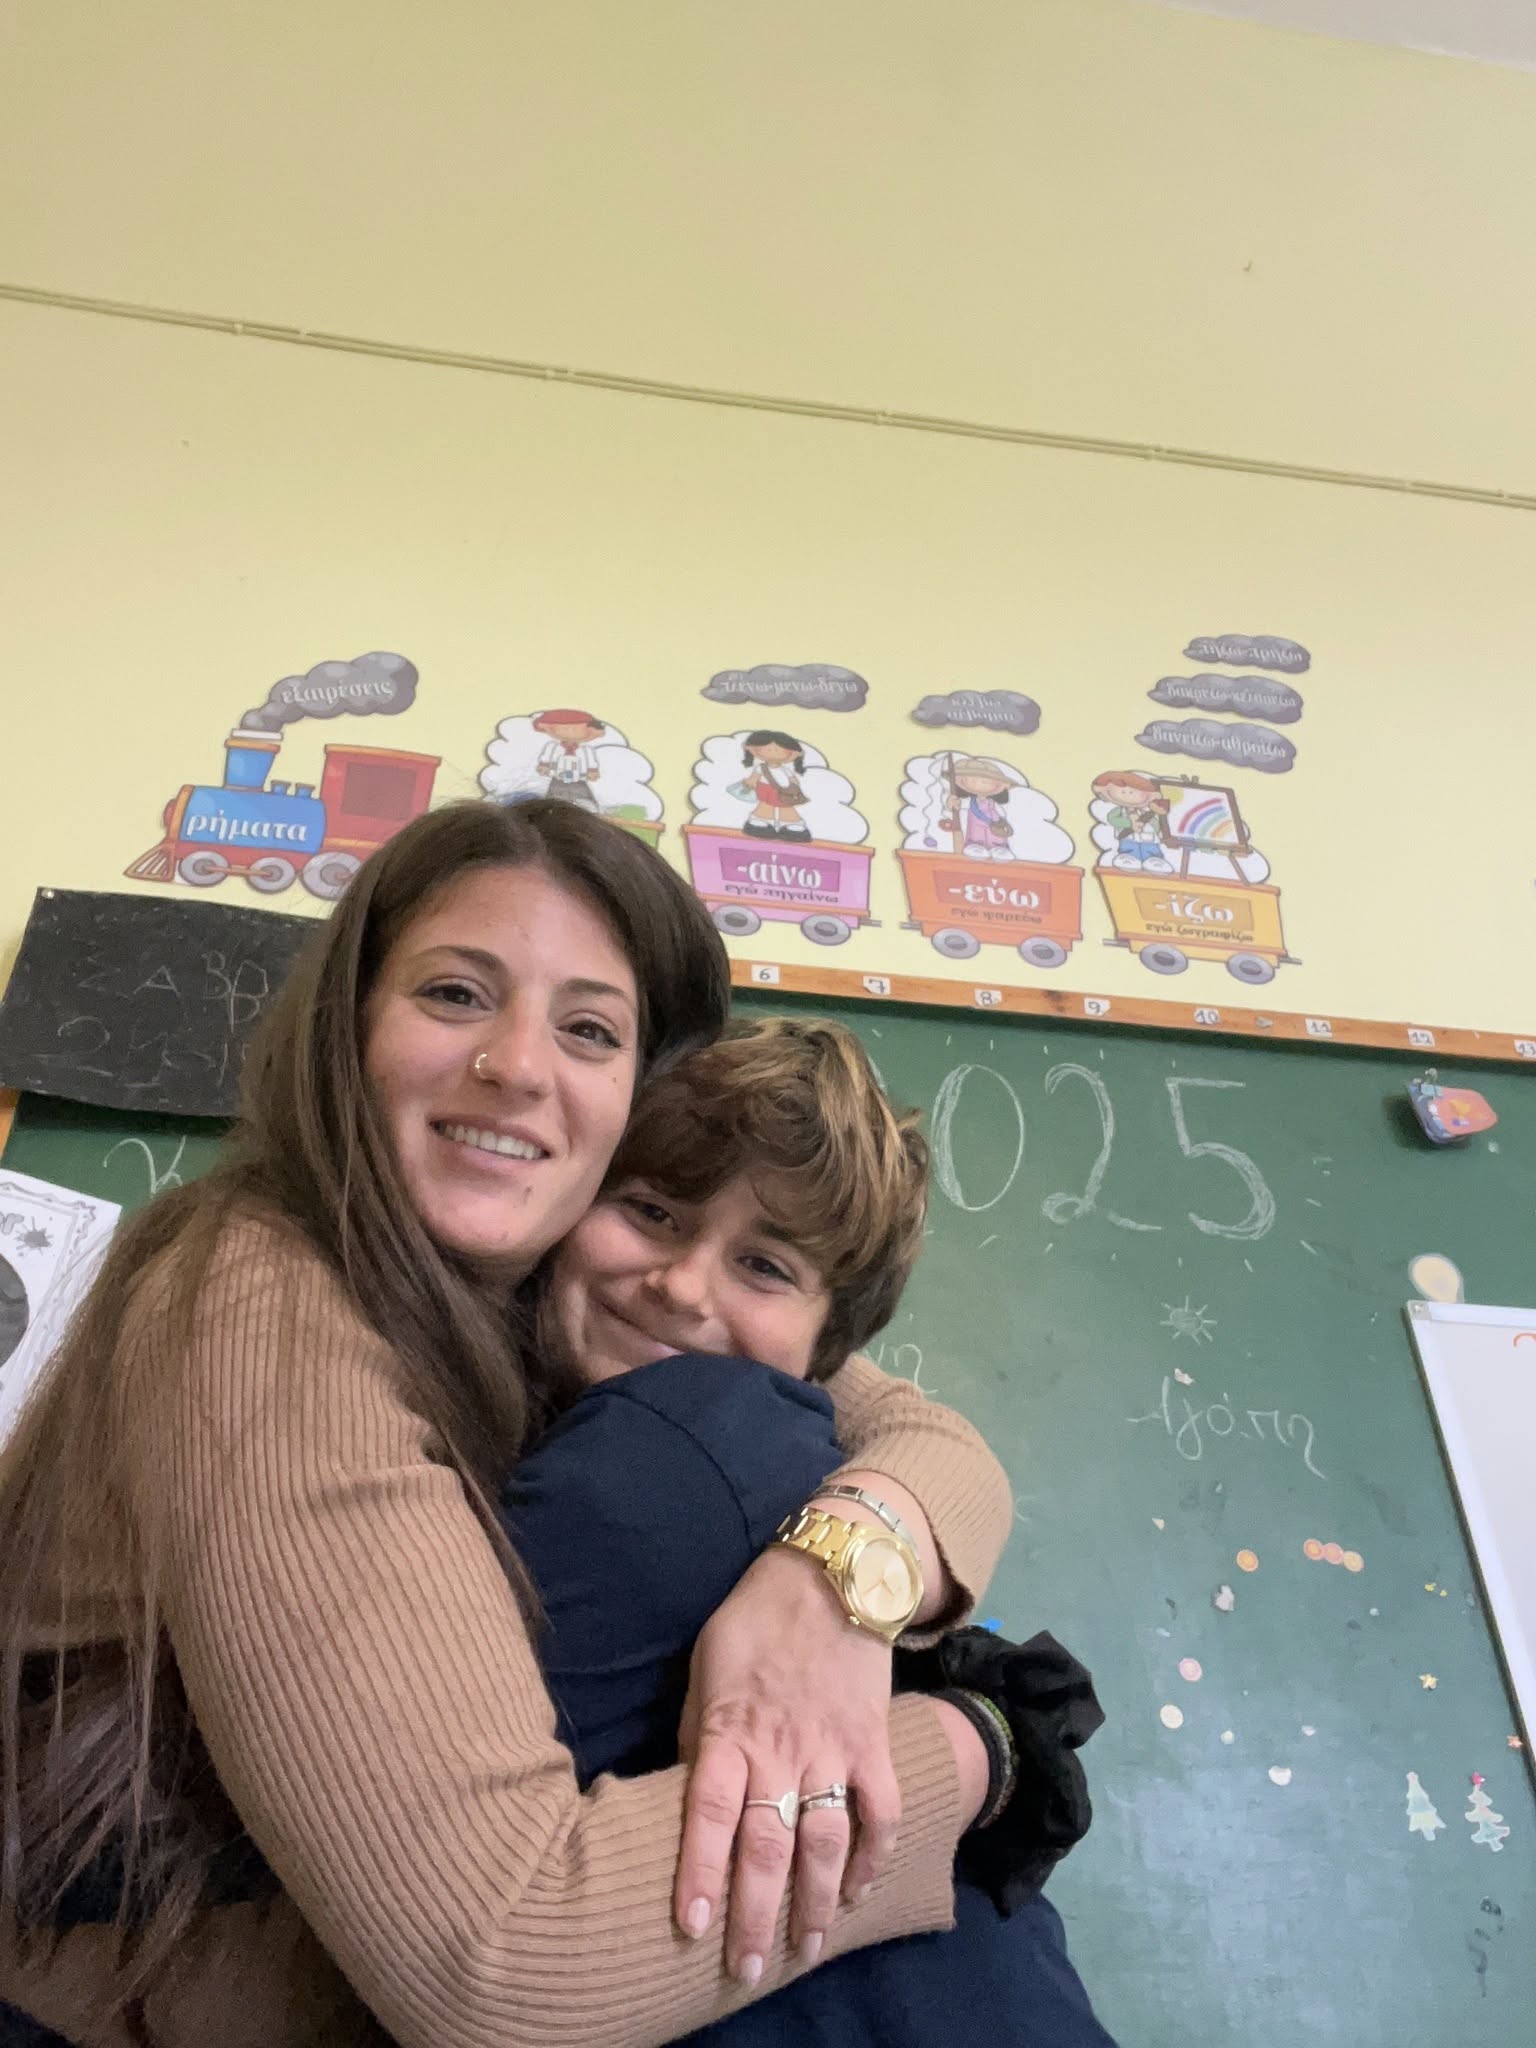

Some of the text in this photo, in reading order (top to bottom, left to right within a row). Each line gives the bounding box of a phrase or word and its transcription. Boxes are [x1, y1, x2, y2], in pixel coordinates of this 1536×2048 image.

[281, 678, 394, 705] εξαιρέσεις
[186, 809, 308, 841] ρήματα
[737, 854, 822, 889] -αίνω
[724, 884, 839, 903] εγώ πηγαίνω
[948, 878, 1041, 909] -εύω
[1155, 893, 1234, 924] -ίζω
[758, 967, 772, 981] 6
[868, 978, 886, 994] 7
[979, 990, 993, 1007] 8
[1088, 1000, 1101, 1014] 9
[1195, 1009, 1219, 1025] 10
[867, 1056, 1276, 1241] 025
